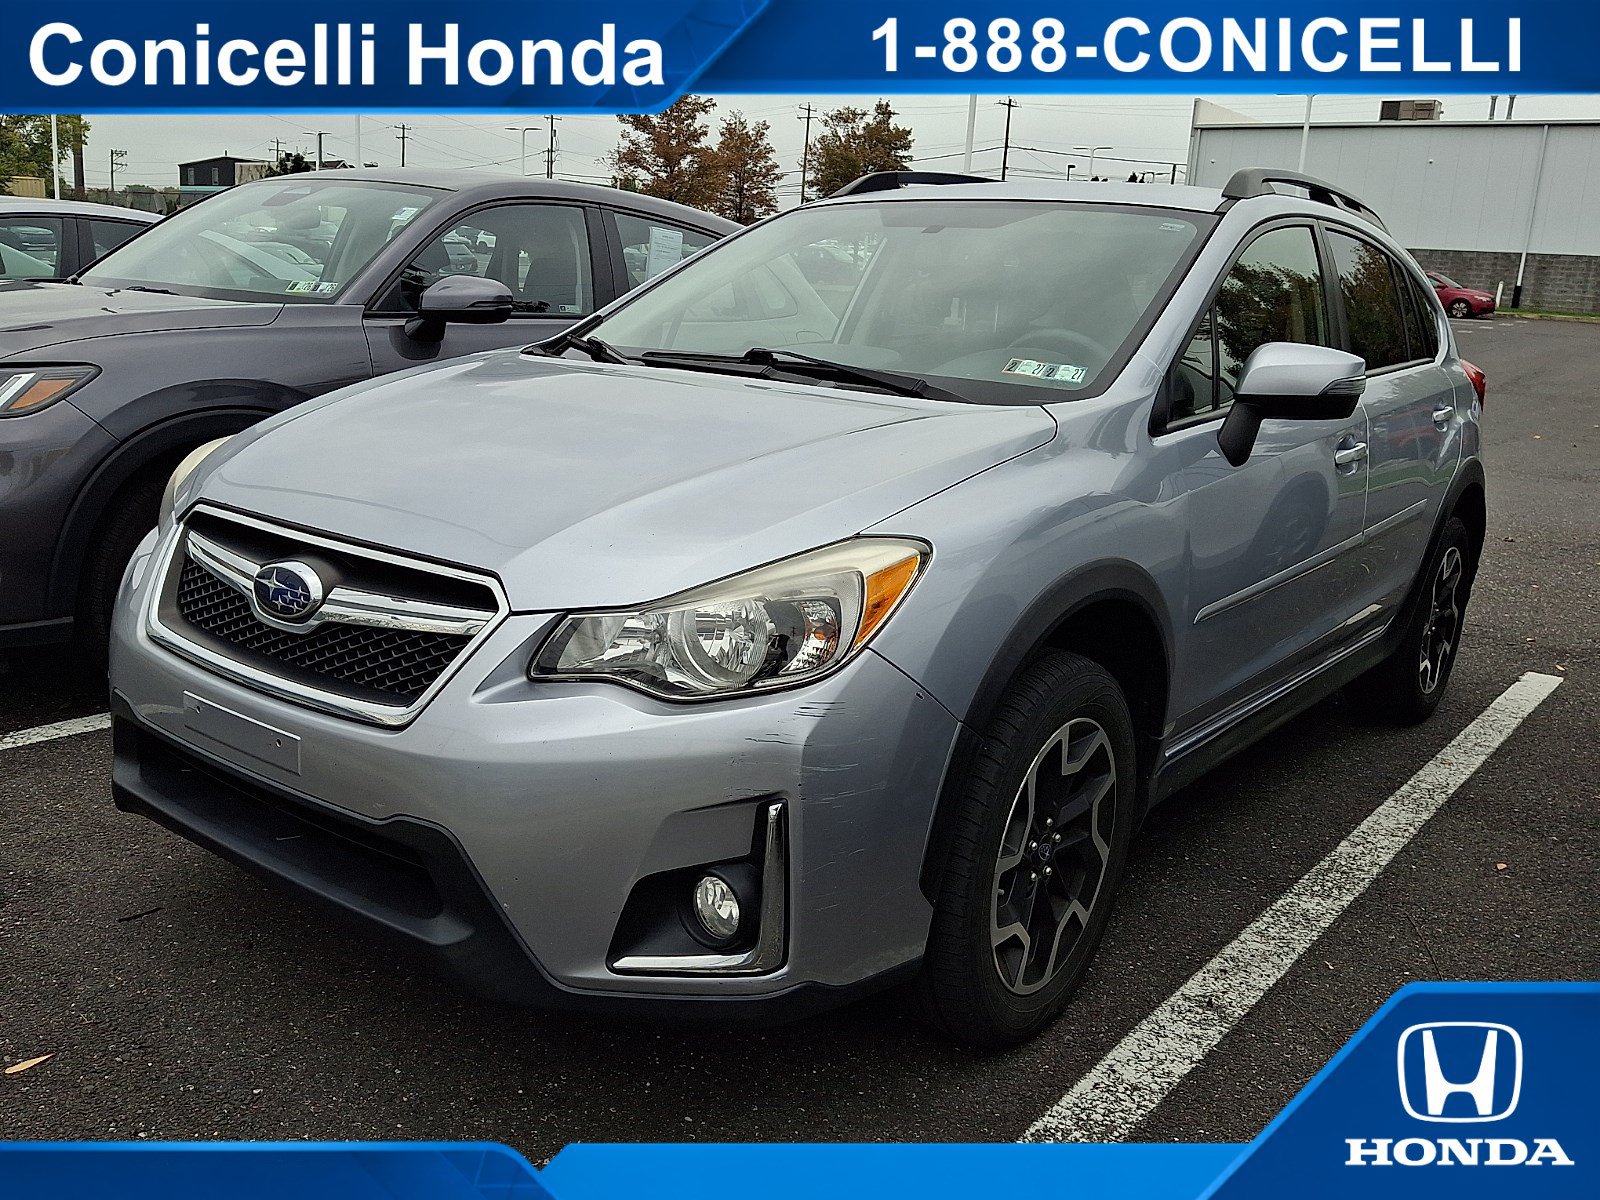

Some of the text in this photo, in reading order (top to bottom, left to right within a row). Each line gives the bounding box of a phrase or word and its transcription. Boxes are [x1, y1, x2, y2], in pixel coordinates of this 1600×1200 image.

[1006, 361, 1085, 381] 2 27 2 27
